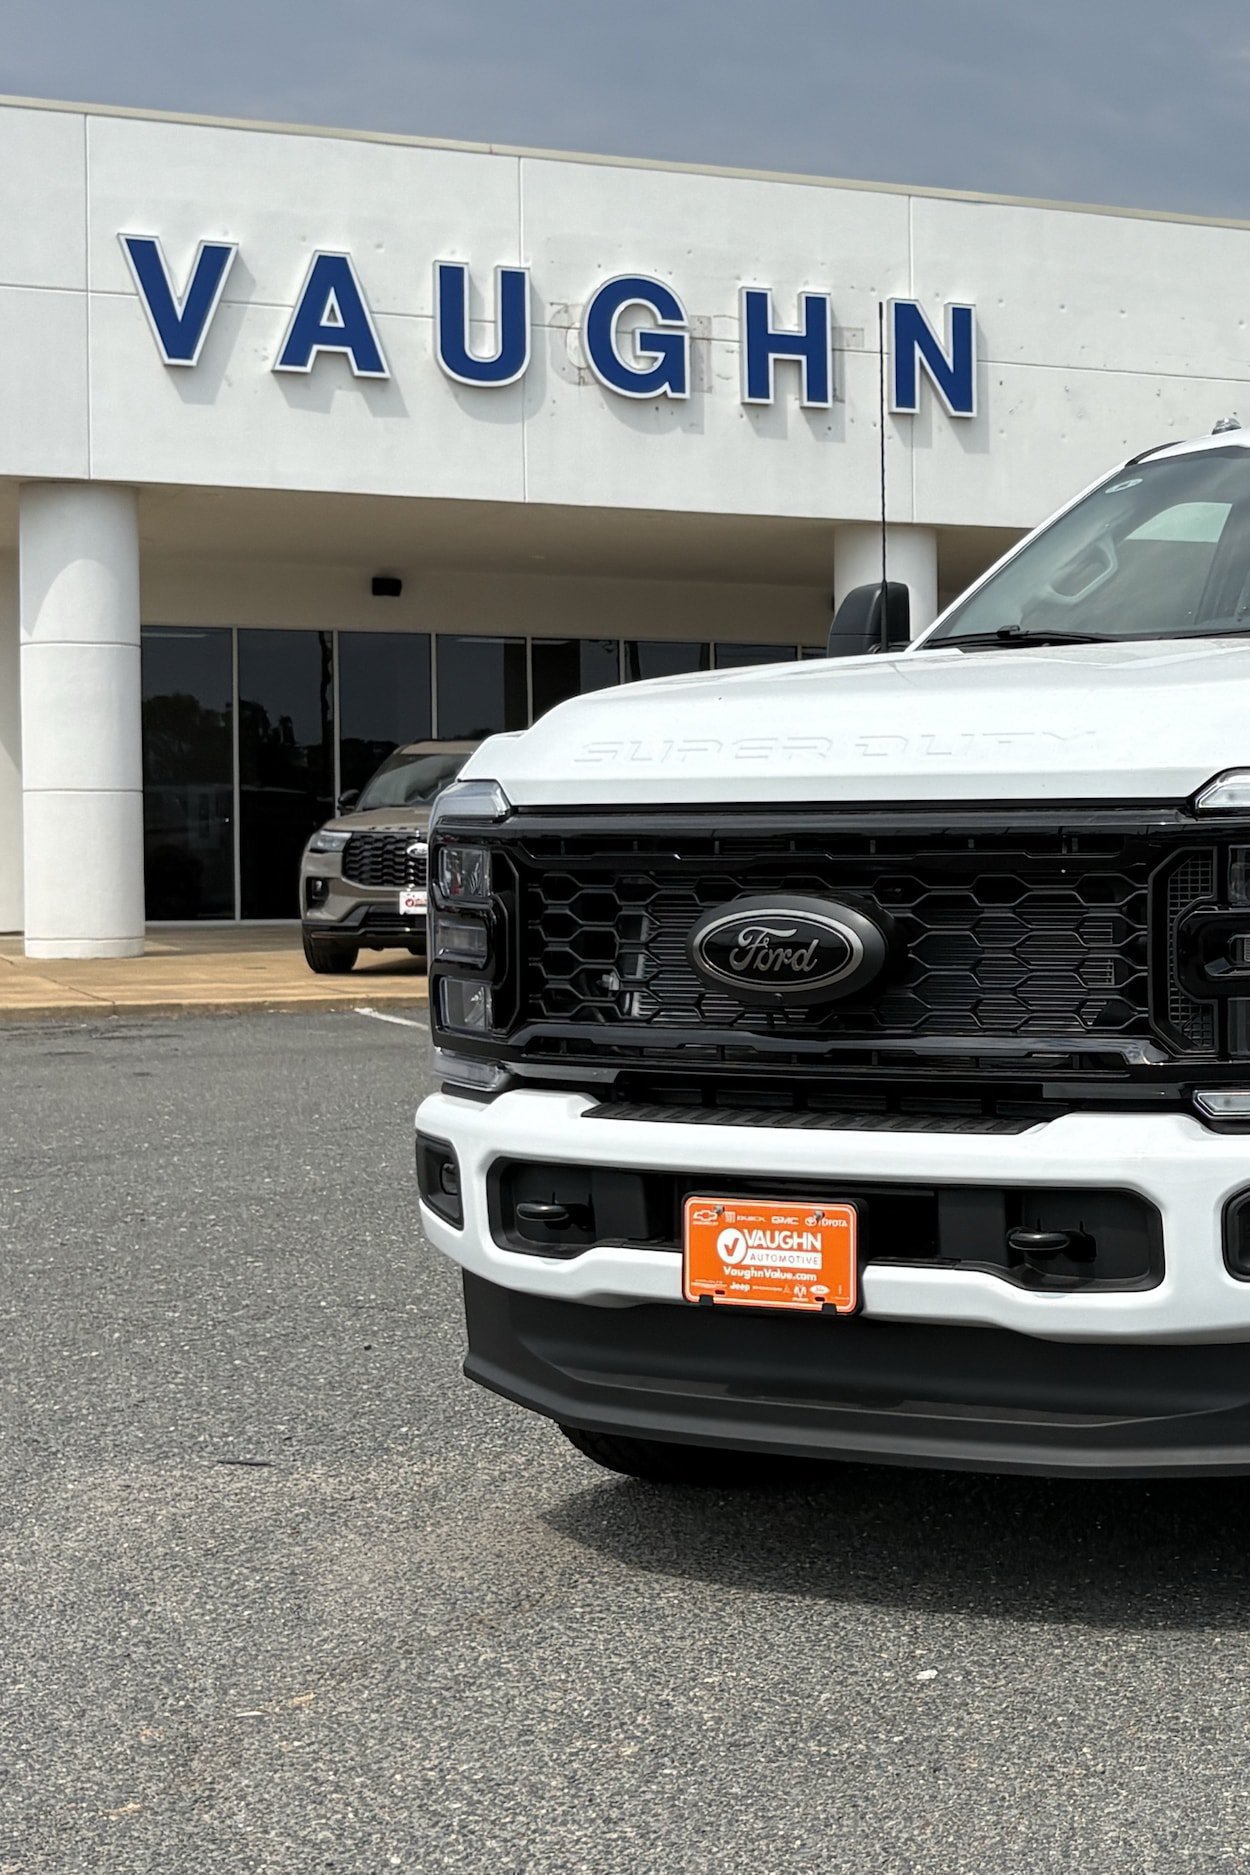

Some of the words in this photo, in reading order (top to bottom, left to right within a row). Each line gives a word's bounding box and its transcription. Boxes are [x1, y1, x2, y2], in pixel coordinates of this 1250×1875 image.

[117, 232, 979, 419] VAUGHN
[573, 736, 833, 764] SUPER
[728, 925, 820, 972] Ford
[771, 1215, 800, 1226] GMC
[742, 1228, 822, 1251] VAUGHN
[750, 1252, 820, 1266] AUTOMOTIVE
[723, 1265, 818, 1281] VaughnValue.com
[729, 1281, 751, 1293] Jeep
